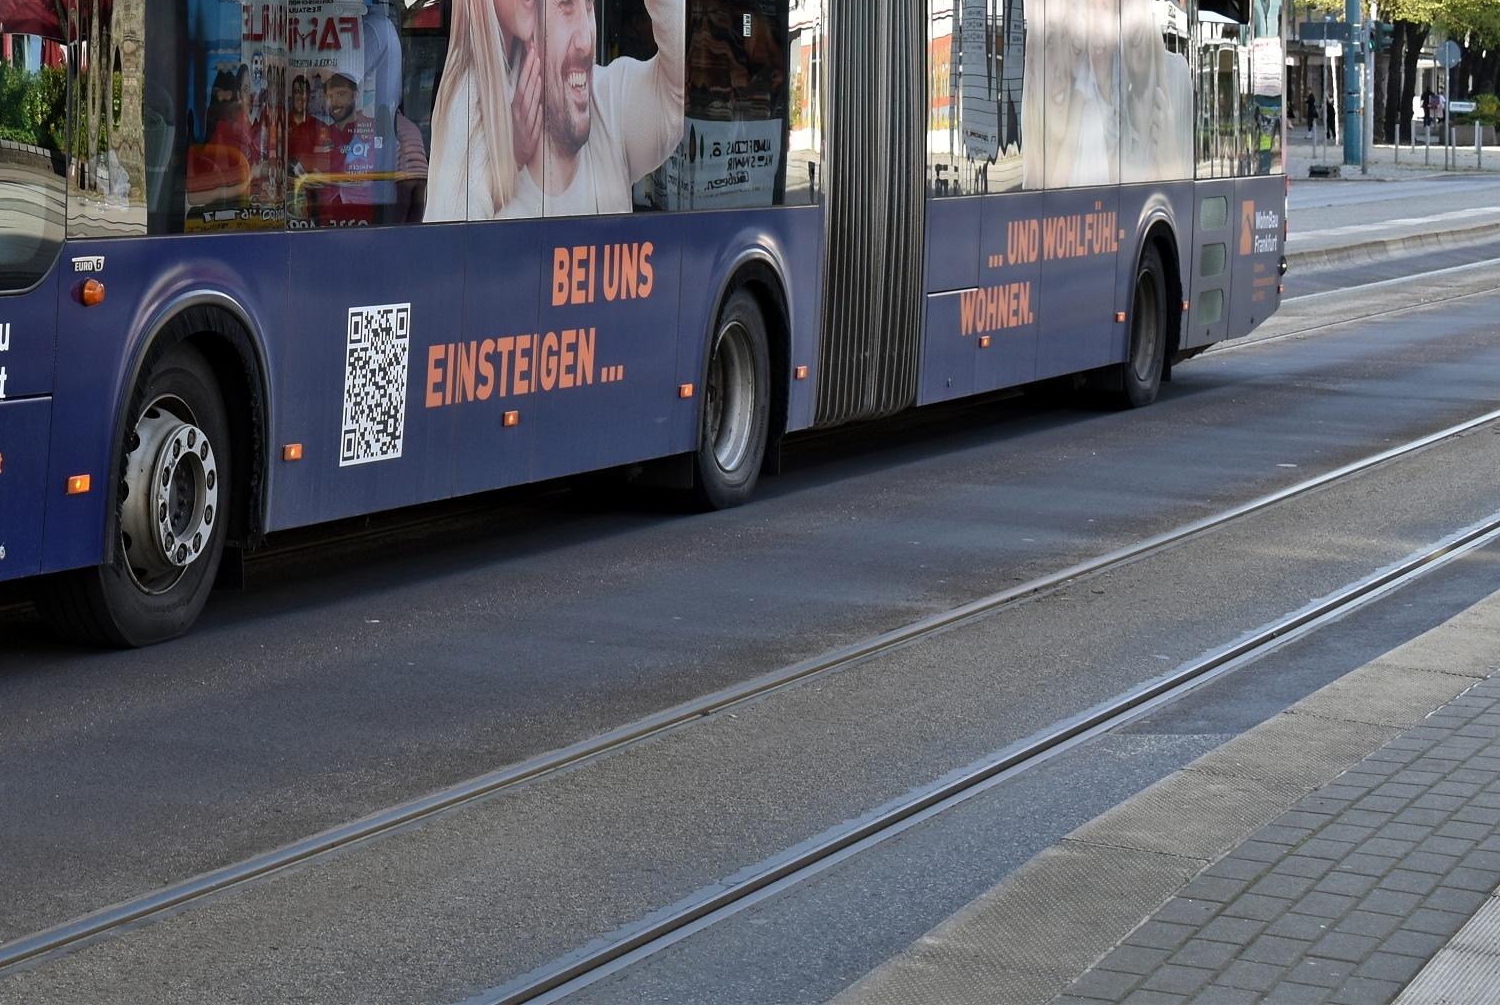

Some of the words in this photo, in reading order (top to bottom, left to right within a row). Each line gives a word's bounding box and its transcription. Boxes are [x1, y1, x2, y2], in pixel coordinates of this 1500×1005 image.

[1007, 220, 1039, 266] UND
[1042, 200, 1126, 262] WOHLFÜHL-
[1254, 233, 1278, 254] Frankfurt
[1255, 210, 1279, 229] WohnBau
[74, 261, 93, 272] EURO
[96, 258, 103, 270] 6
[552, 245, 596, 306] BEI
[603, 241, 654, 302] UNS
[960, 281, 1034, 336] WOHNEN.
[425, 327, 596, 408] EINSTEIGEN
